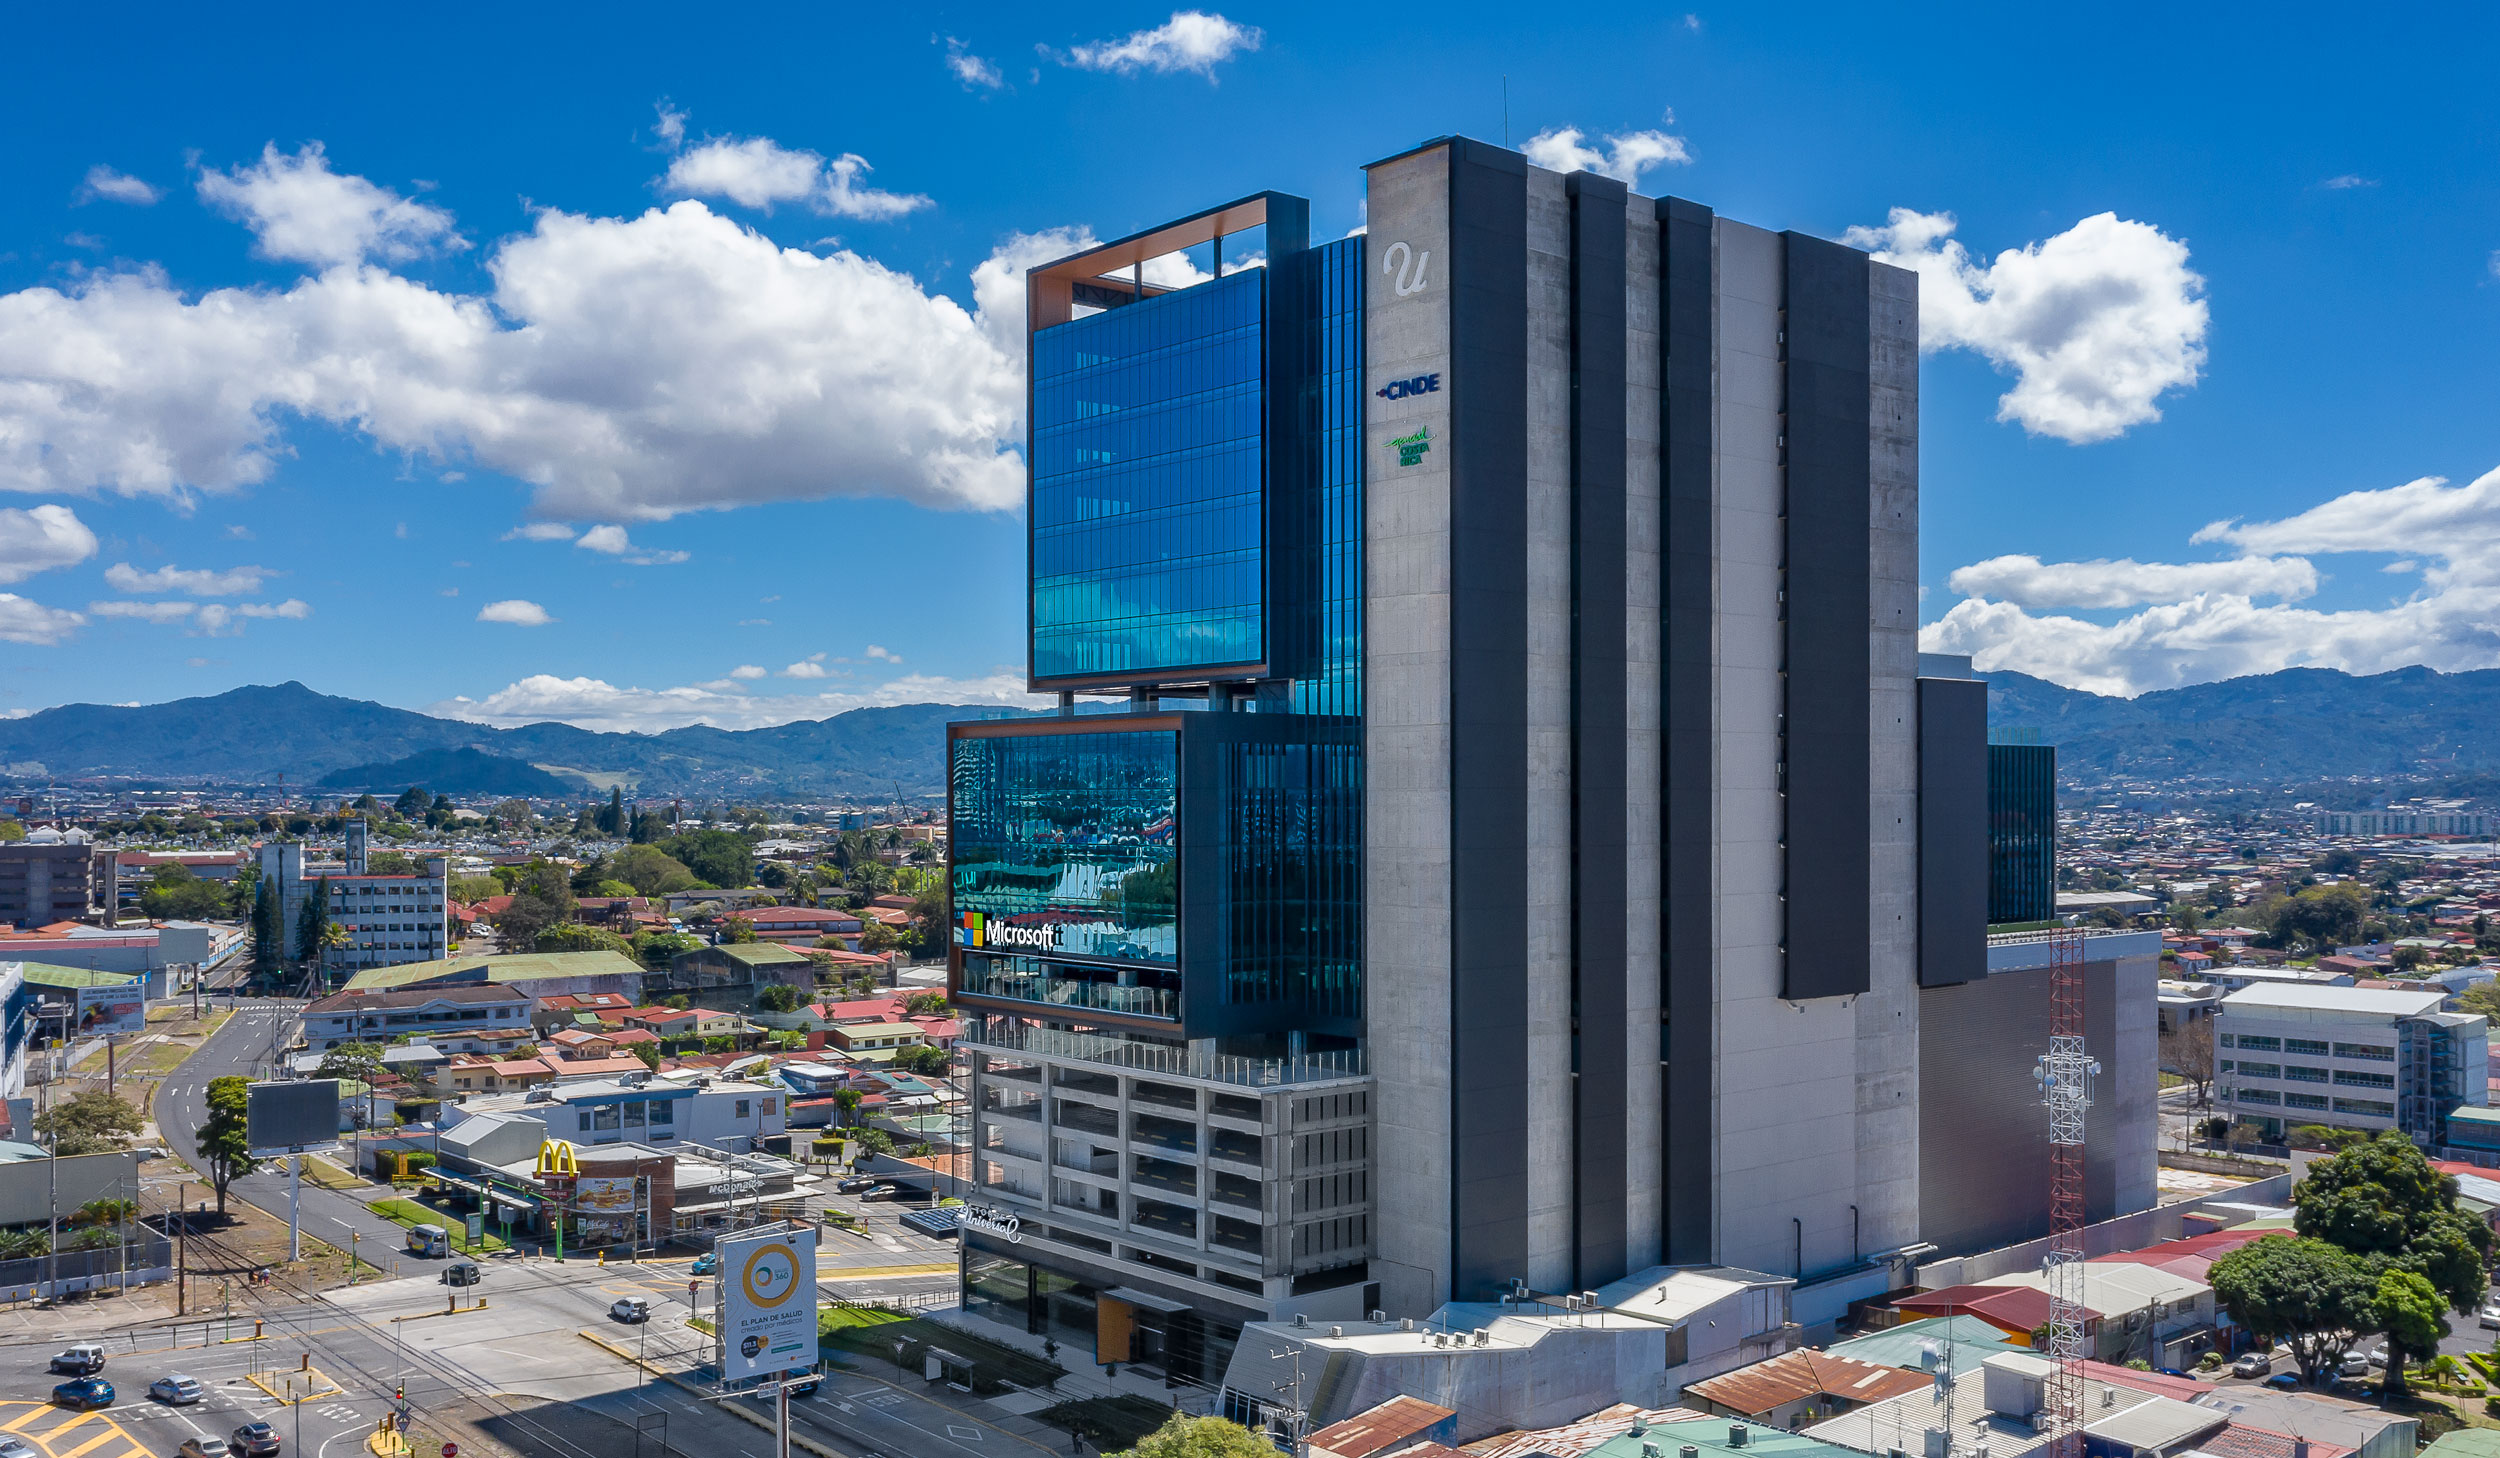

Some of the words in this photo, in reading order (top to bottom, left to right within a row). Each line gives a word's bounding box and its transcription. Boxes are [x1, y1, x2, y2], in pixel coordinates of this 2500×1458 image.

[1386, 373, 1441, 401] CINDE
[1400, 442, 1430, 456] COSTA
[1400, 455, 1423, 467] RICA
[986, 920, 1054, 947] Microsoft
[975, 1206, 1006, 1221] TORRE
[959, 1205, 1022, 1243] Universal
[775, 1272, 789, 1281] 360
[750, 1316, 768, 1325] PLAN
[781, 1310, 803, 1318] SALUD
[765, 1322, 775, 1331] por
[442, 1446, 458, 1455] ALTO
